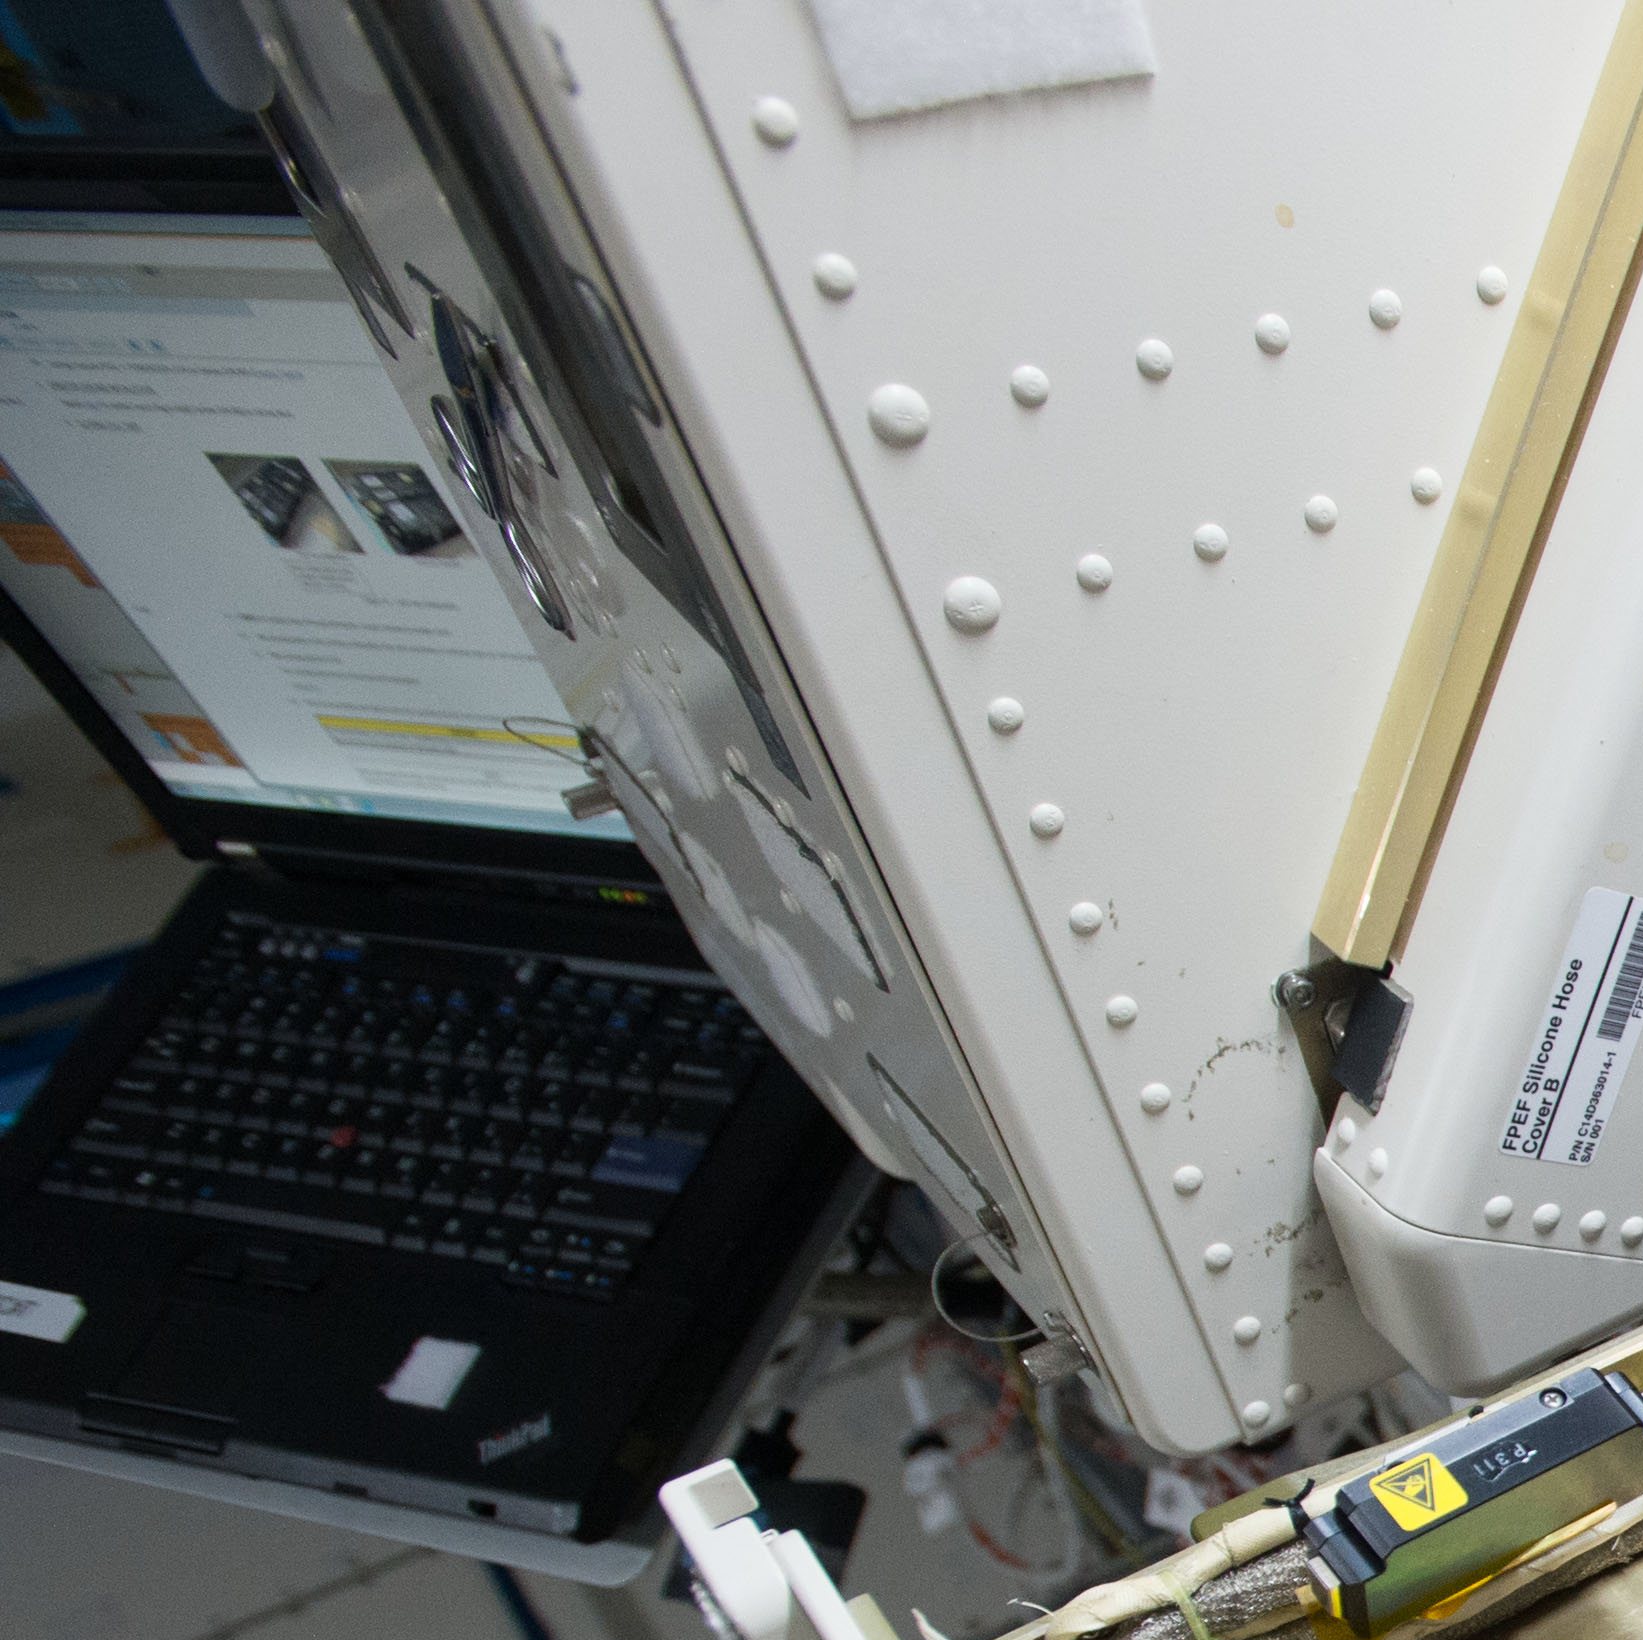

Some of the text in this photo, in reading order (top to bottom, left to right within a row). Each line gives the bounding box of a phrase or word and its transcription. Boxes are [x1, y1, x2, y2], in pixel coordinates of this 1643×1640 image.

[1502, 957, 1583, 1151] FPEF Silicone Hose
[1521, 1077, 1560, 1154] Cover B
[1568, 1050, 1617, 1162] P/N C14D363014-1
[1580, 1117, 1605, 1163] S/N 001
[1473, 1443, 1527, 1476] P311
